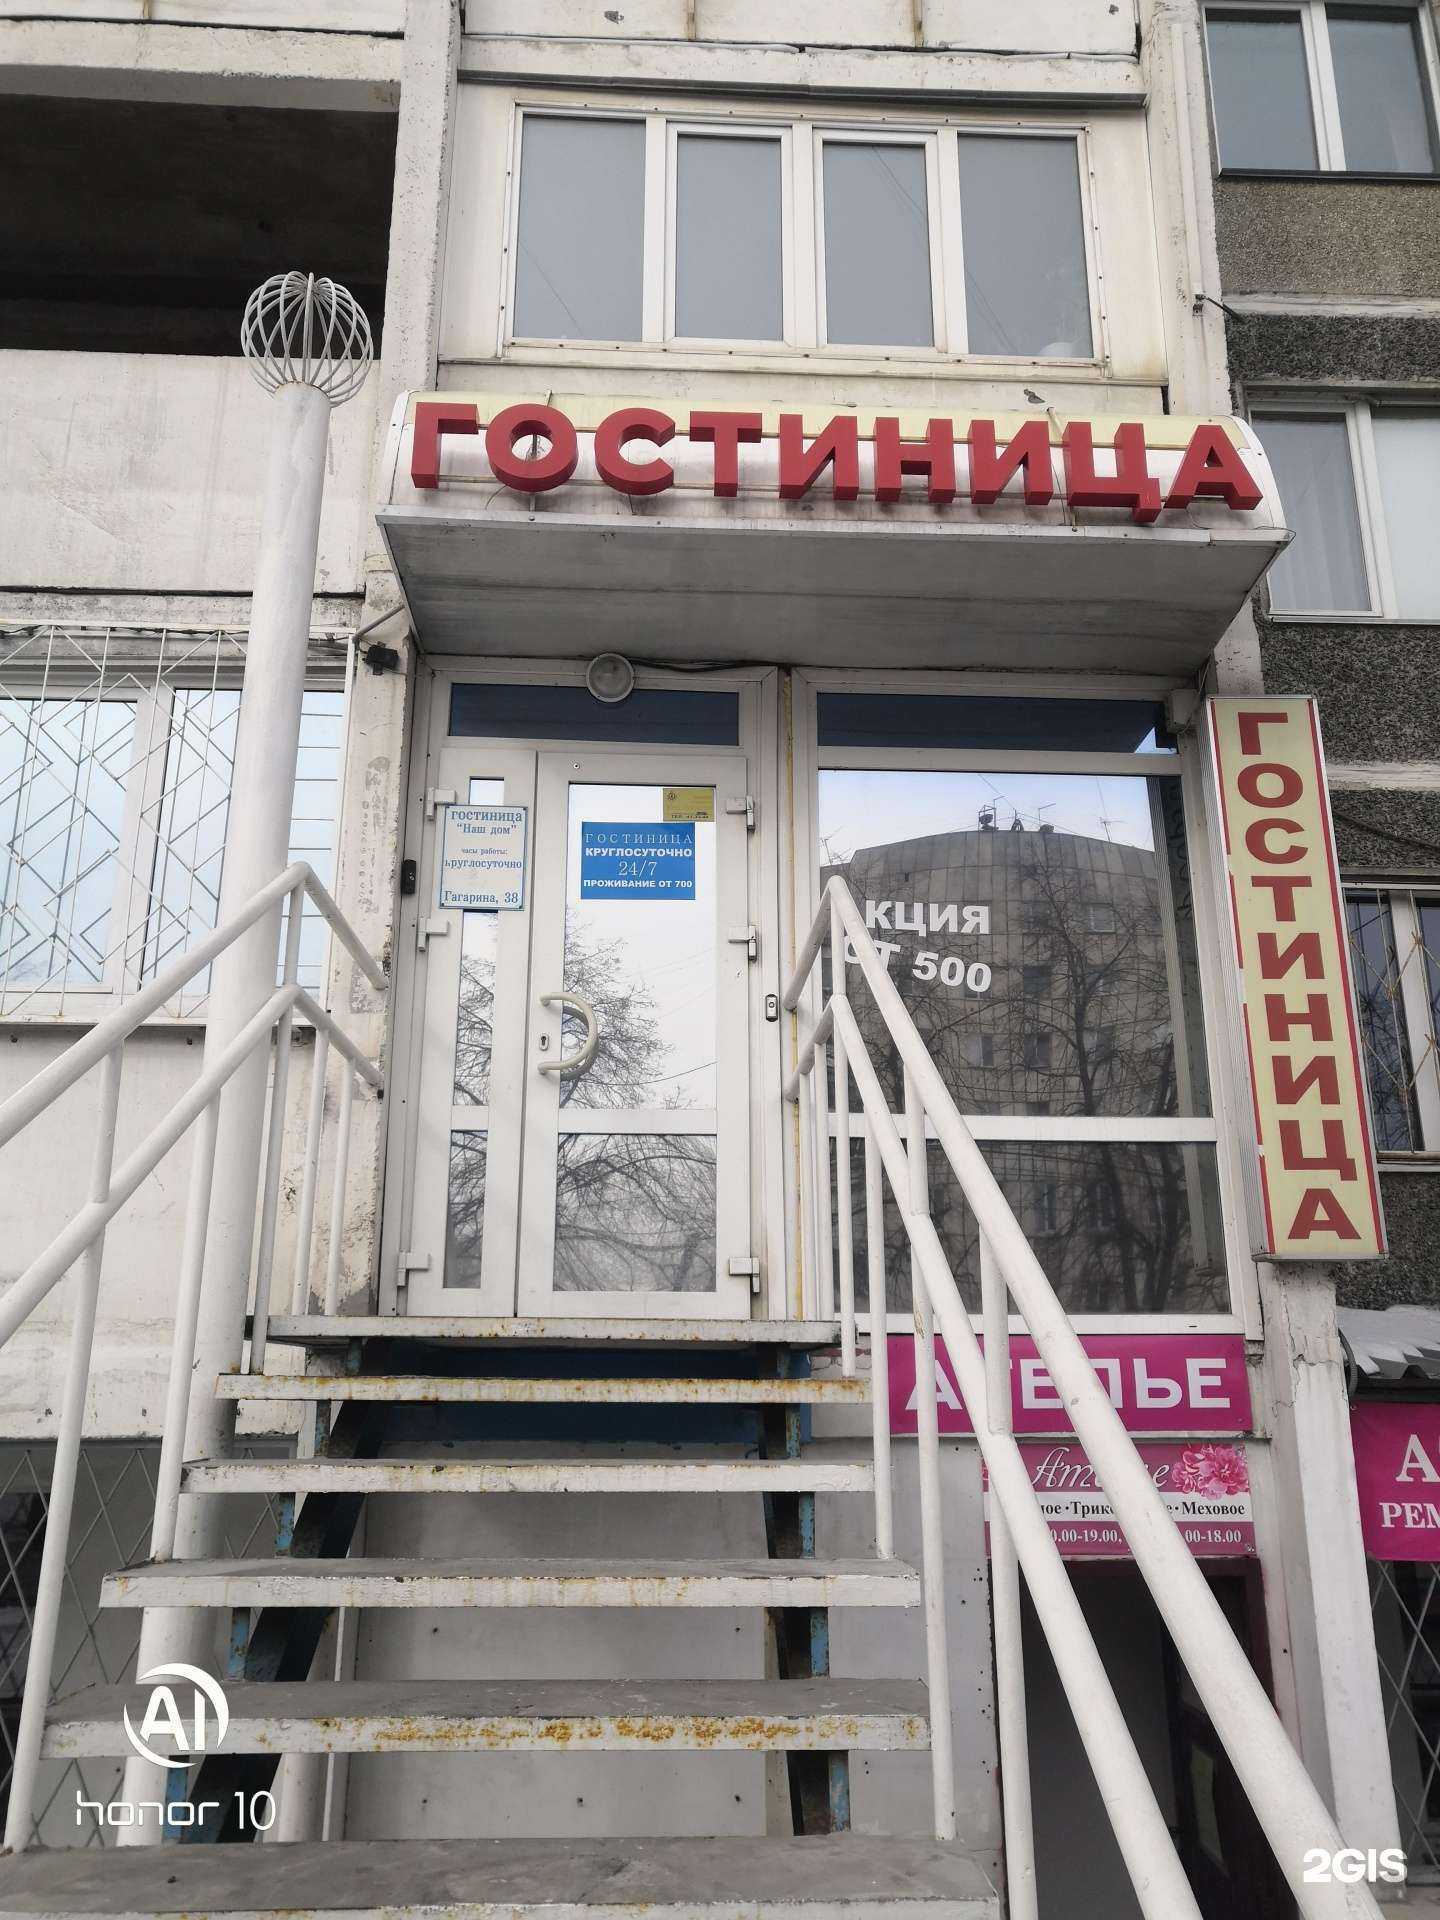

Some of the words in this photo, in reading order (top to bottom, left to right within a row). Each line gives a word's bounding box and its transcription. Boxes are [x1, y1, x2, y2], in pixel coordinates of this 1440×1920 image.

[411, 402, 1263, 523] ГОСТИНИЦА
[451, 811, 522, 823] гостиница
[585, 833, 693, 844] ГОСТИНИЦА
[585, 847, 693, 857] КРУГЛОСУТОЧНО
[618, 860, 658, 877] 24/7
[583, 880, 656, 888] ПРОЖИВАНИЕ
[658, 880, 672, 888] ОТ
[674, 880, 692, 888] 700
[445, 890, 499, 904] Гагарина,
[504, 892, 518, 904] 38
[866, 900, 989, 936] КЦИЯ
[912, 951, 992, 993] 500
[1237, 711, 1362, 1240] ГОСТИНИЦА
[905, 1358, 1231, 1411] АЕЛЬЕ
[1182, 1501, 1245, 1515] Меховое
